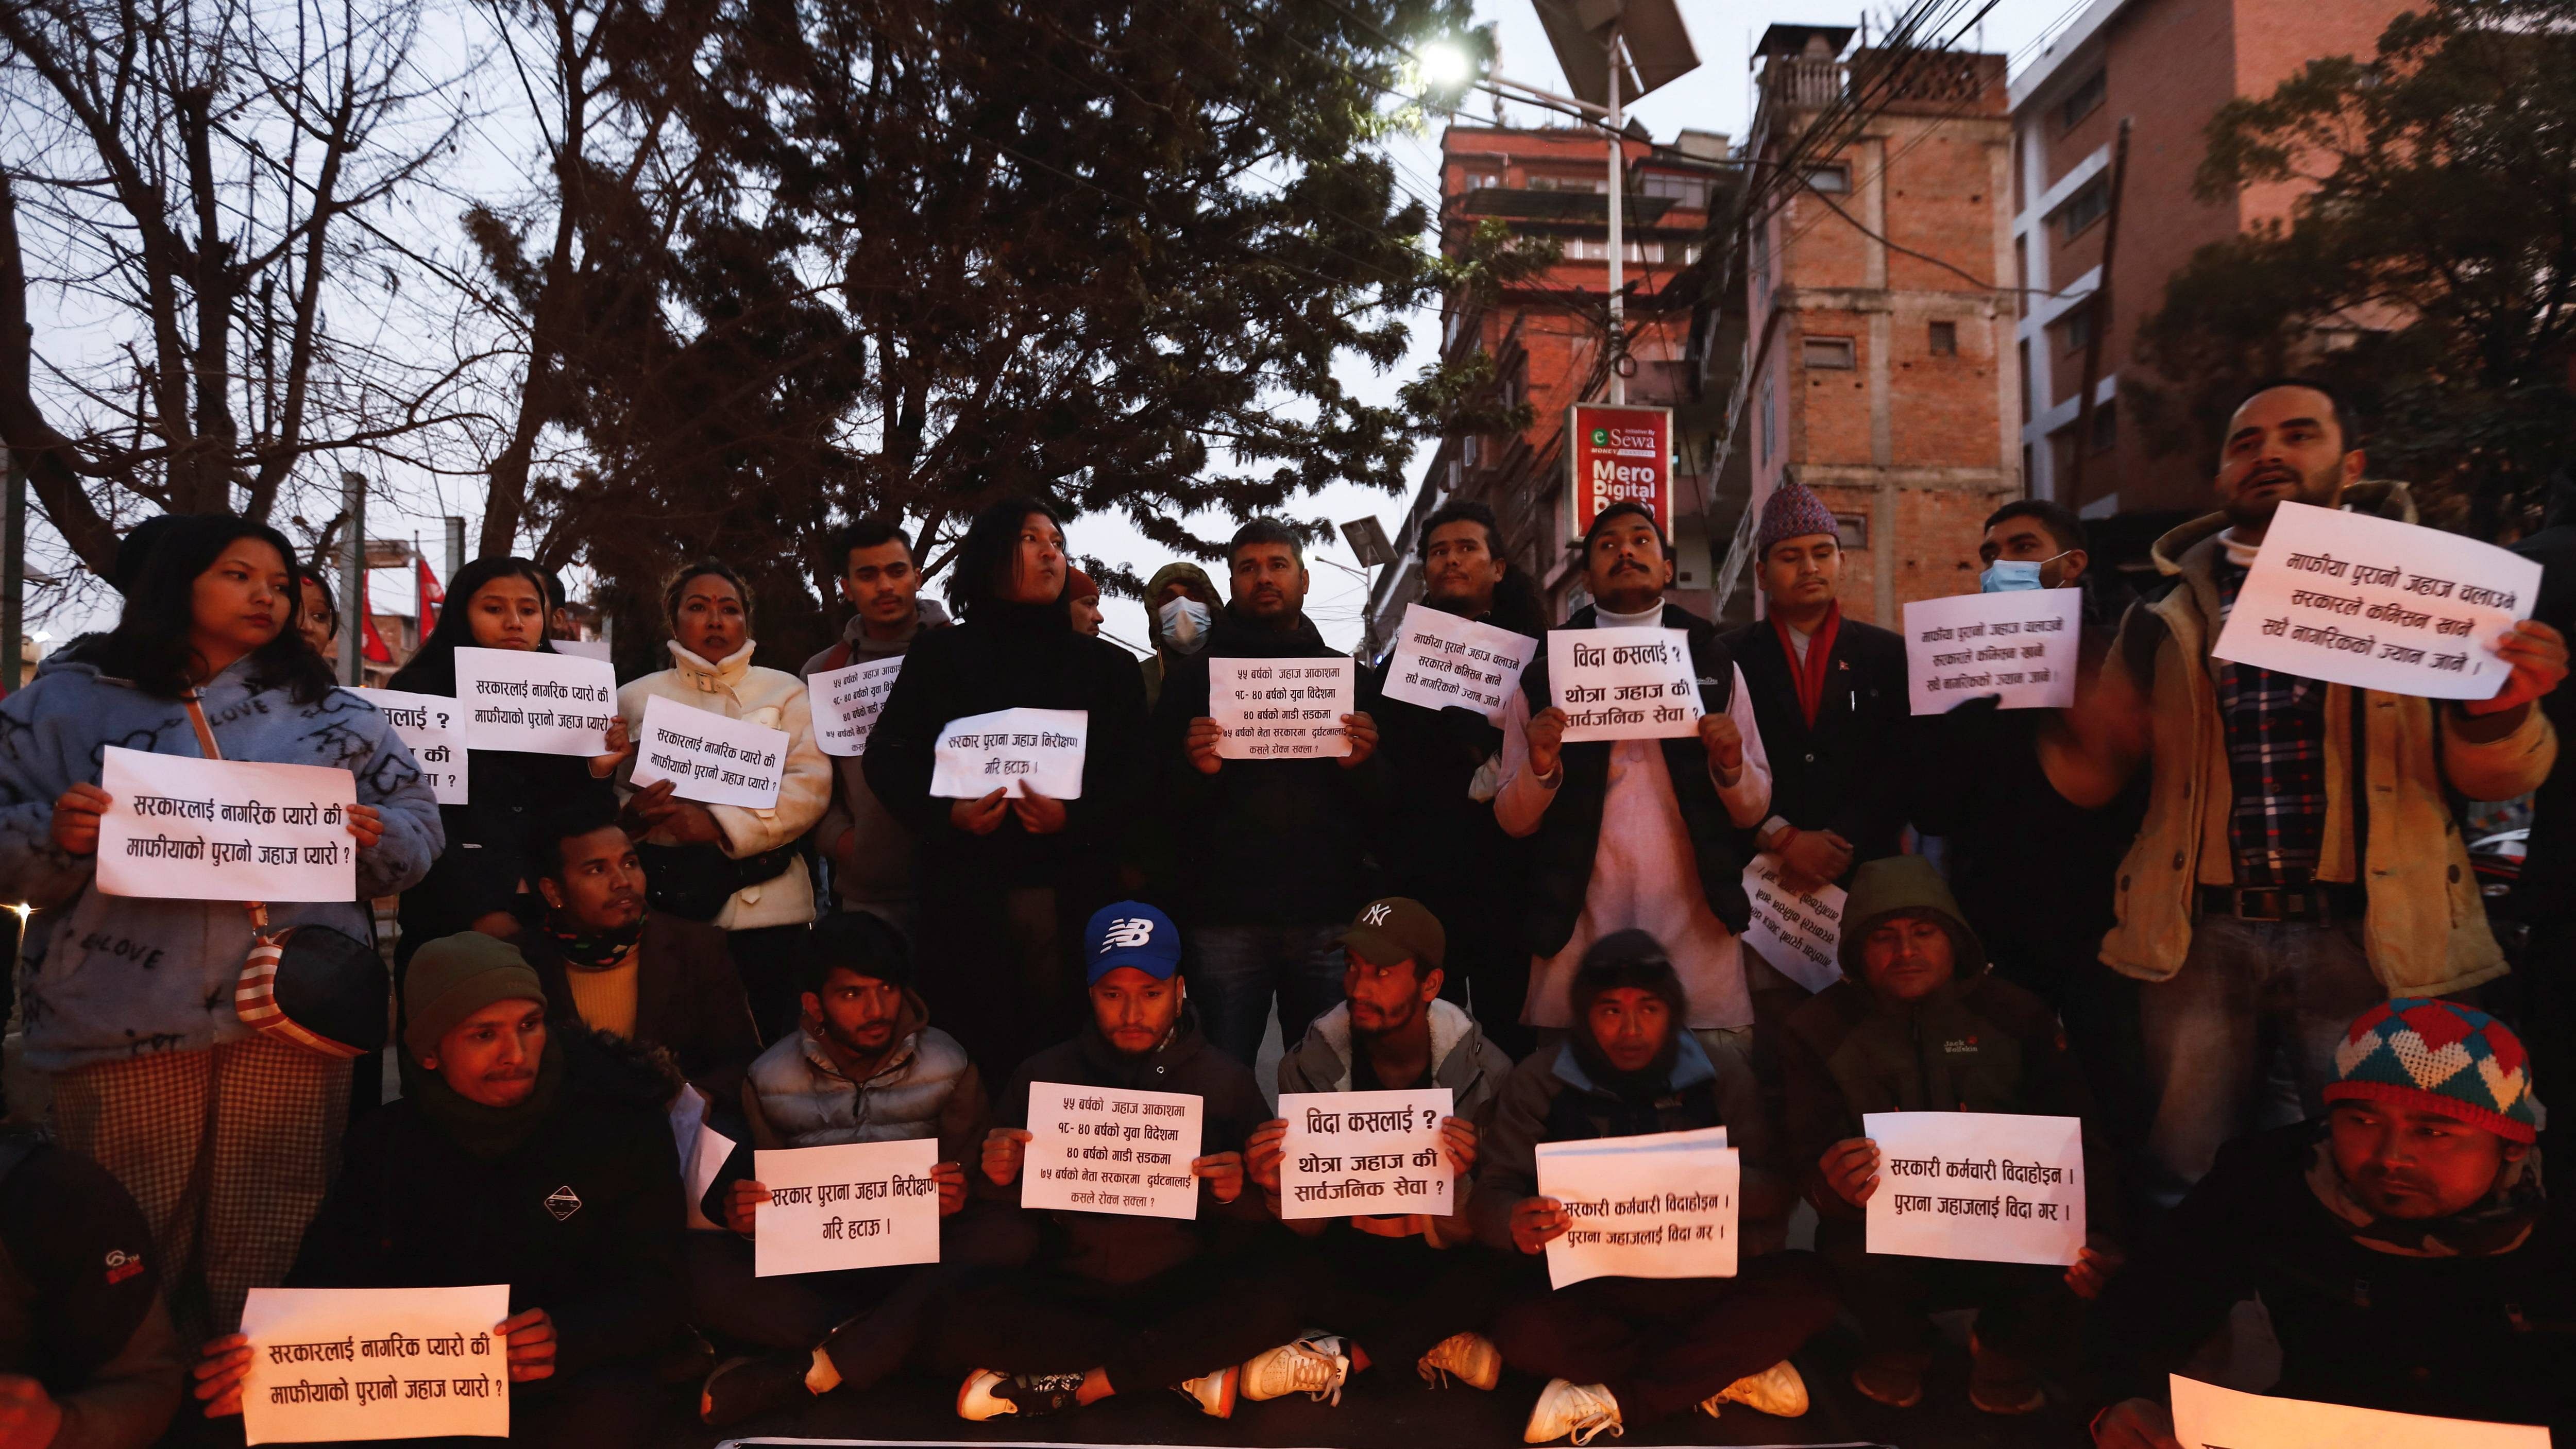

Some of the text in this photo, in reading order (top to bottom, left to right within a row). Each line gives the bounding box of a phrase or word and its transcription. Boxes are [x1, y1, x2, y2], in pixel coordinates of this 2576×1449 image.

[1611, 429, 1655, 448] Sewa
[1594, 459, 1655, 482] Mero
[1594, 479, 1655, 500] Digital
[1414, 634, 1520, 670] माफीया पुरानो जहाज चलाउने
[1574, 641, 1667, 667] विदा कसलाई
[1238, 670, 1247, 679] ५५
[1279, 669, 1300, 679] जहाज
[1305, 668, 1340, 678] आकाशमा
[1419, 656, 1501, 686] सरकारले कमिसन खाने
[477, 680, 608, 702] सरकारलाई नागरिक प्यारो की
[1252, 691, 1262, 700] ४०
[1291, 690, 1304, 702] युवा
[1308, 686, 1335, 698] विदेशमा
[1420, 677, 1460, 694] नागरिकको
[1484, 695, 1500, 707] जाने
[1566, 685, 1606, 703] थोत्रा
[1614, 685, 1663, 700] जहाज
[1672, 679, 1690, 695] की
[209, 700, 269, 727] LOVE
[475, 706, 609, 732] माफीयाको पुरानो जहाज प्यारो
[1282, 708, 1299, 719] गाडी
[1302, 710, 1331, 720] सडकमा
[1653, 705, 1684, 723] सेवा
[1223, 729, 1232, 738] ७५
[1258, 727, 1270, 737] नेता
[425, 745, 451, 762] की
[657, 728, 775, 768] सरकारलाई नागरिक प्यारो की
[1250, 744, 1269, 754] कसले
[651, 753, 769, 790] माफीयाको पुरानो जहाज प्यारो
[134, 796, 342, 825] सरकारलाई नागरिक प्यारो की
[127, 834, 338, 866] माफीयाको पुरानो जहाज प्यारो
[1363, 904, 1392, 926] NY
[1063, 1098, 1185, 1117] ५५ आकाशमा
[1307, 1104, 1413, 1134] विदा कसलाई
[1124, 1124, 1179, 1141] युवा विदेशमा
[1112, 1148, 1171, 1164] गाडी सडकमा
[1299, 1148, 1437, 1173] थोत्रा जहाज की
[1041, 1168, 1191, 1188] ७५ नेता सरकारमा दुर्घटनालाई
[1891, 1156, 1940, 1177] सरकारी
[1946, 1158, 1996, 1181] कर्मचारी
[772, 1174, 936, 1207] सरकार पुराना जहाज निरीक्षण
[1071, 1190, 1095, 1203] कसले
[1295, 1177, 1427, 1201] सार्वजनिक सेवा
[1564, 1199, 1608, 1217] सरकारी
[1615, 1196, 1660, 1215] कर्मचारी
[1895, 1195, 2058, 1220] पुराना जहाजलाई विदा गर
[823, 1216, 880, 1239] गरि हटाऊ
[1568, 1225, 1712, 1248] पुराना जहाजलाई विदा गर
[269, 1332, 489, 1364] सरकारलाई नागरिक की
[270, 1375, 397, 1406] माफीयाको पुरानो
